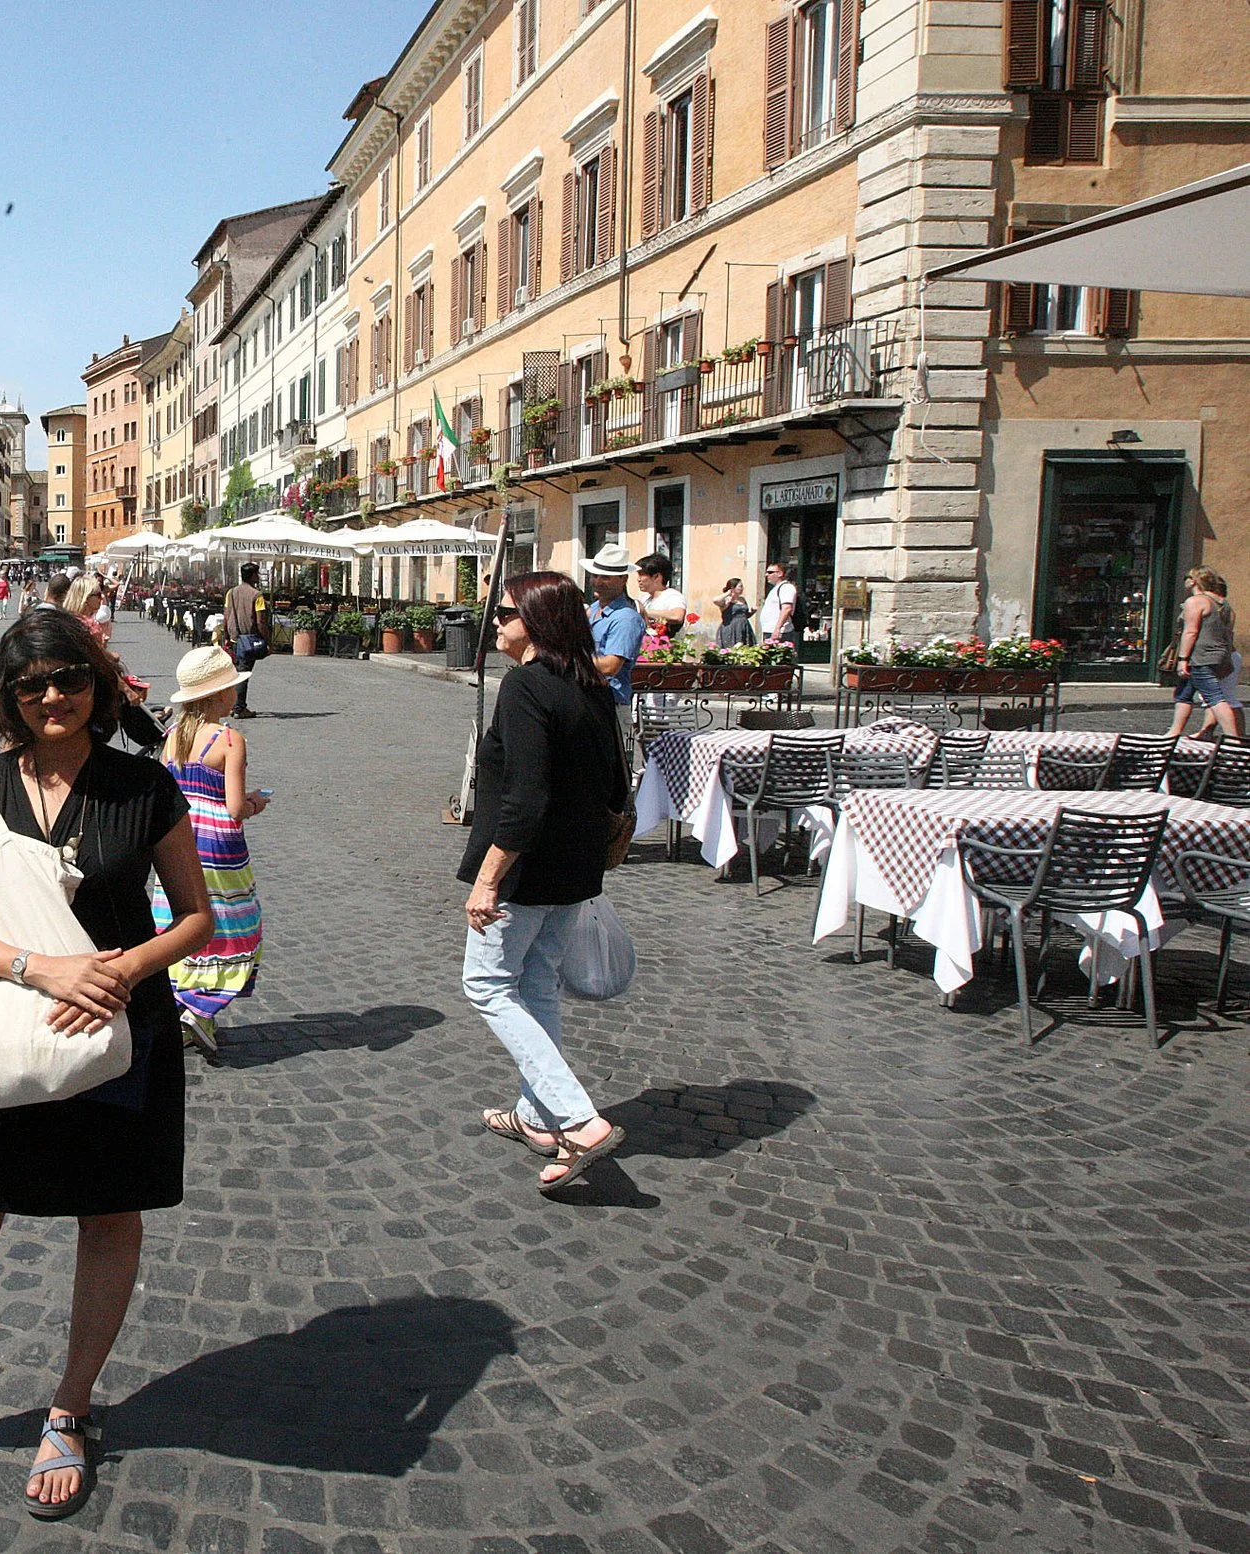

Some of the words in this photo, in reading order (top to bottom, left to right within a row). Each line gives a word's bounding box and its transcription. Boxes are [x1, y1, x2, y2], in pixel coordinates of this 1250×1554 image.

[232, 541, 290, 554] RISTORANTE
[299, 545, 341, 558] PIZZERIA
[382, 545, 430, 554] COCKTAIL
